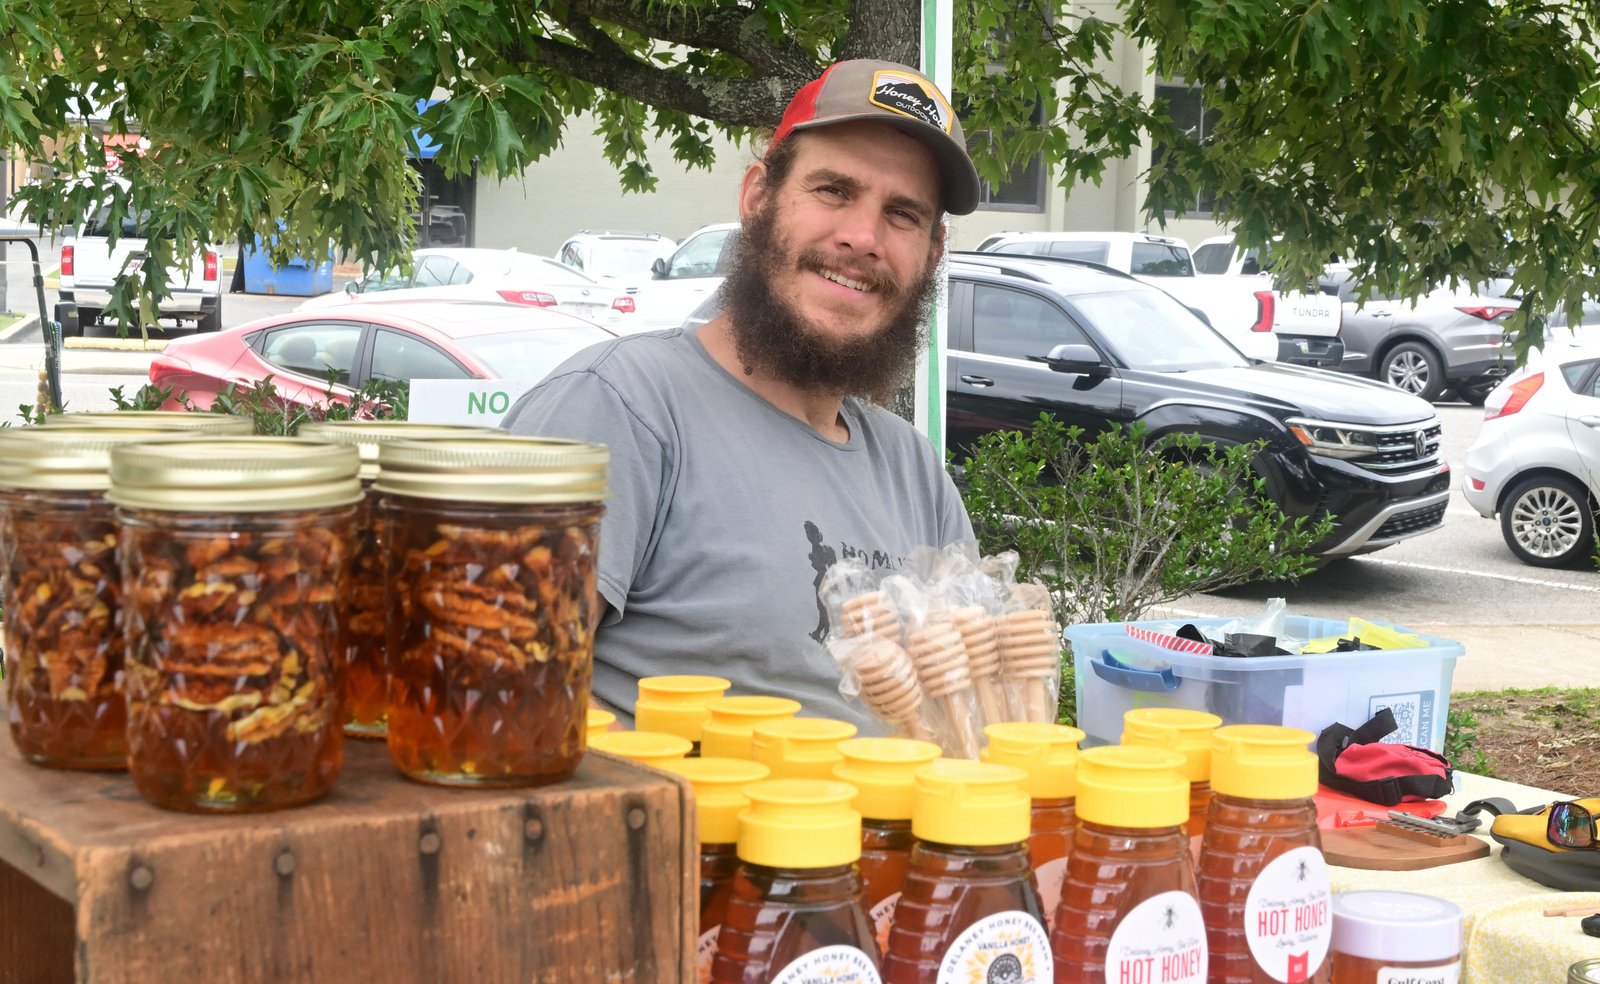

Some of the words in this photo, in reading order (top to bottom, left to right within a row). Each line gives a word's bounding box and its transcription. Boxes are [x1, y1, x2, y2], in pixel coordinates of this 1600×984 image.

[876, 85, 923, 107] Honey
[1293, 307, 1330, 319] TUNDRA
[467, 391, 510, 414] NO
[1422, 699, 1432, 719] ME
[1258, 907, 1290, 938] HOT
[1294, 899, 1329, 933] HONEY
[946, 928, 985, 974] DELANEY
[989, 917, 1023, 930] HONEY
[977, 940, 1008, 951] VANILLA
[1010, 935, 1031, 947] HONEY
[814, 953, 849, 965] HONEY
[1120, 957, 1155, 984] HOT
[1162, 946, 1202, 984] HONEY
